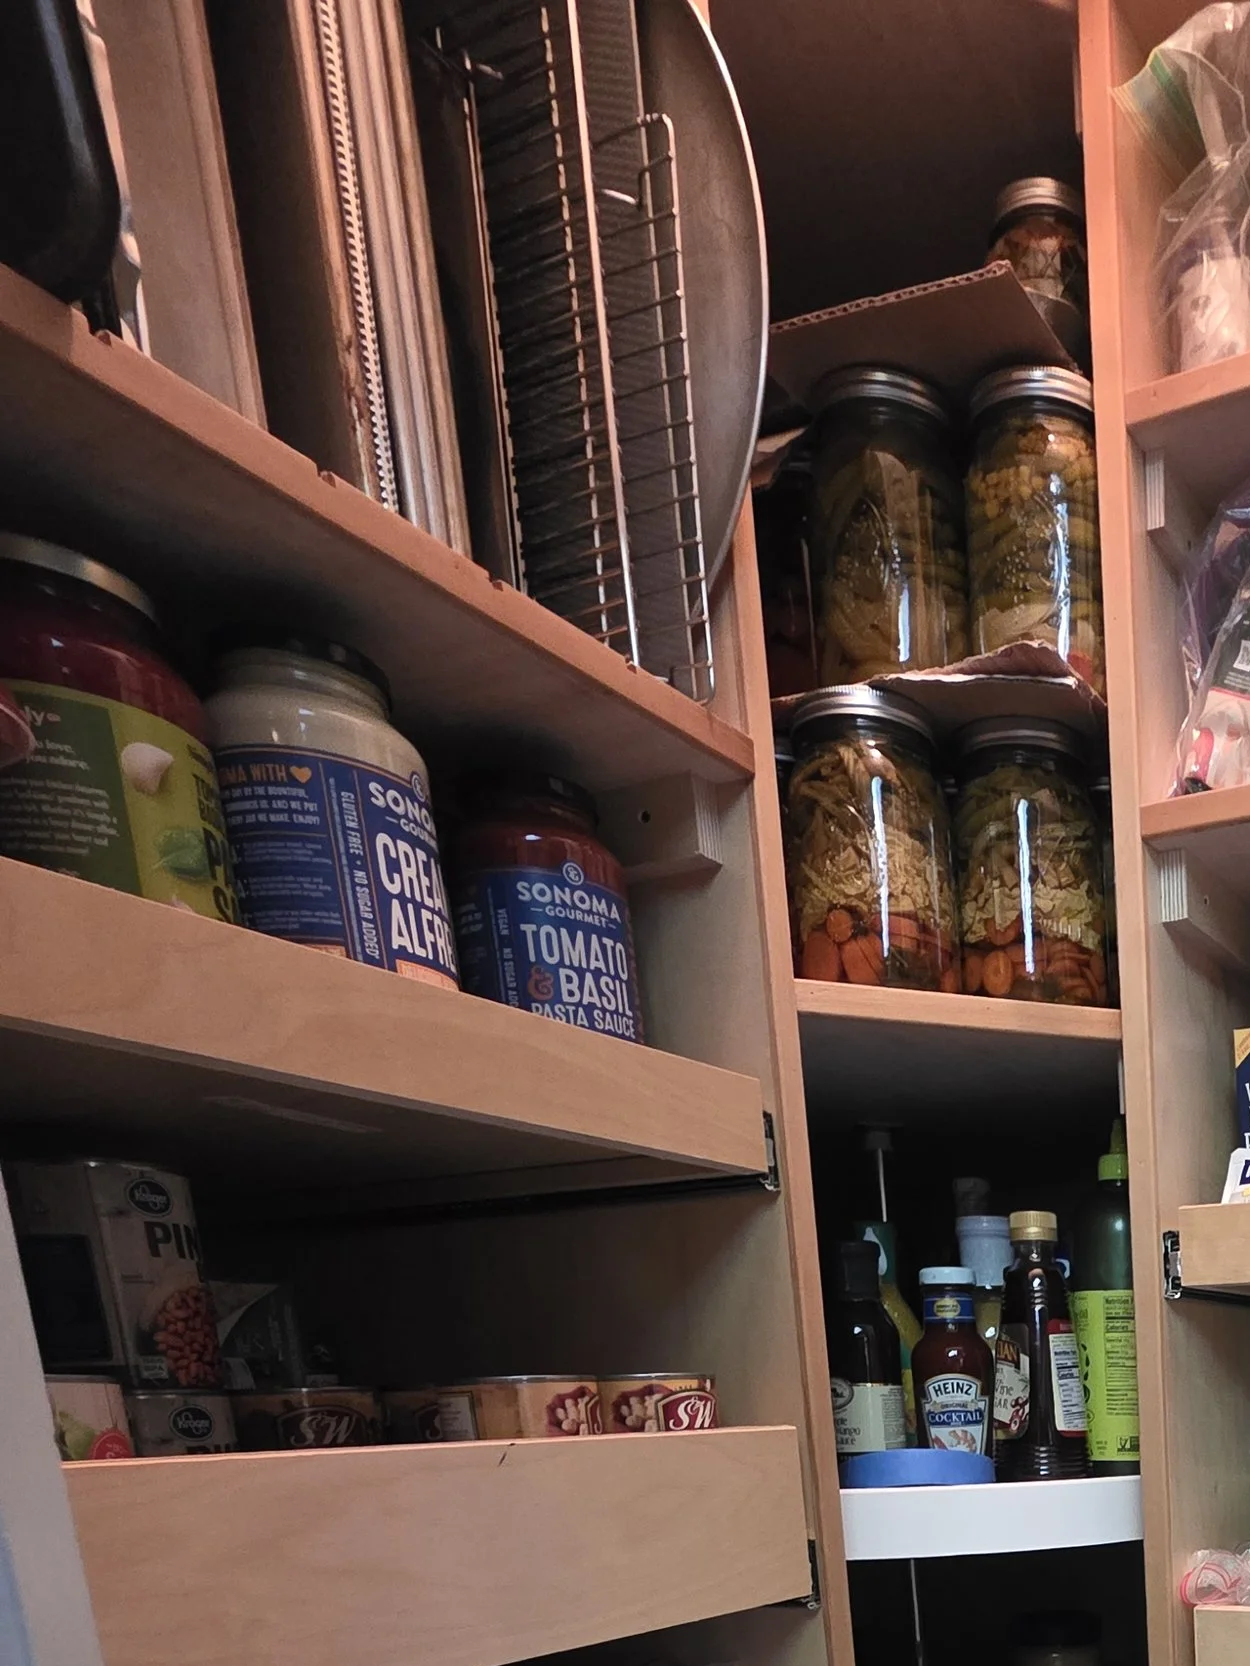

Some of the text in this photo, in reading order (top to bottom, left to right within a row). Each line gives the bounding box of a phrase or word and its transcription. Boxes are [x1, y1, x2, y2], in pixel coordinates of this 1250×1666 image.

[341, 791, 374, 919] GLUTEN FREE NO SUGAR
[516, 881, 622, 923] SONOMA
[545, 905, 609, 928] GOURMET
[520, 924, 628, 981] TOMATO
[558, 968, 633, 1017] BASIL
[531, 1002, 636, 1039] PASTA SAUCE
[933, 1381, 973, 1398] HEINZ
[928, 1410, 982, 1424] COCKTAIL
